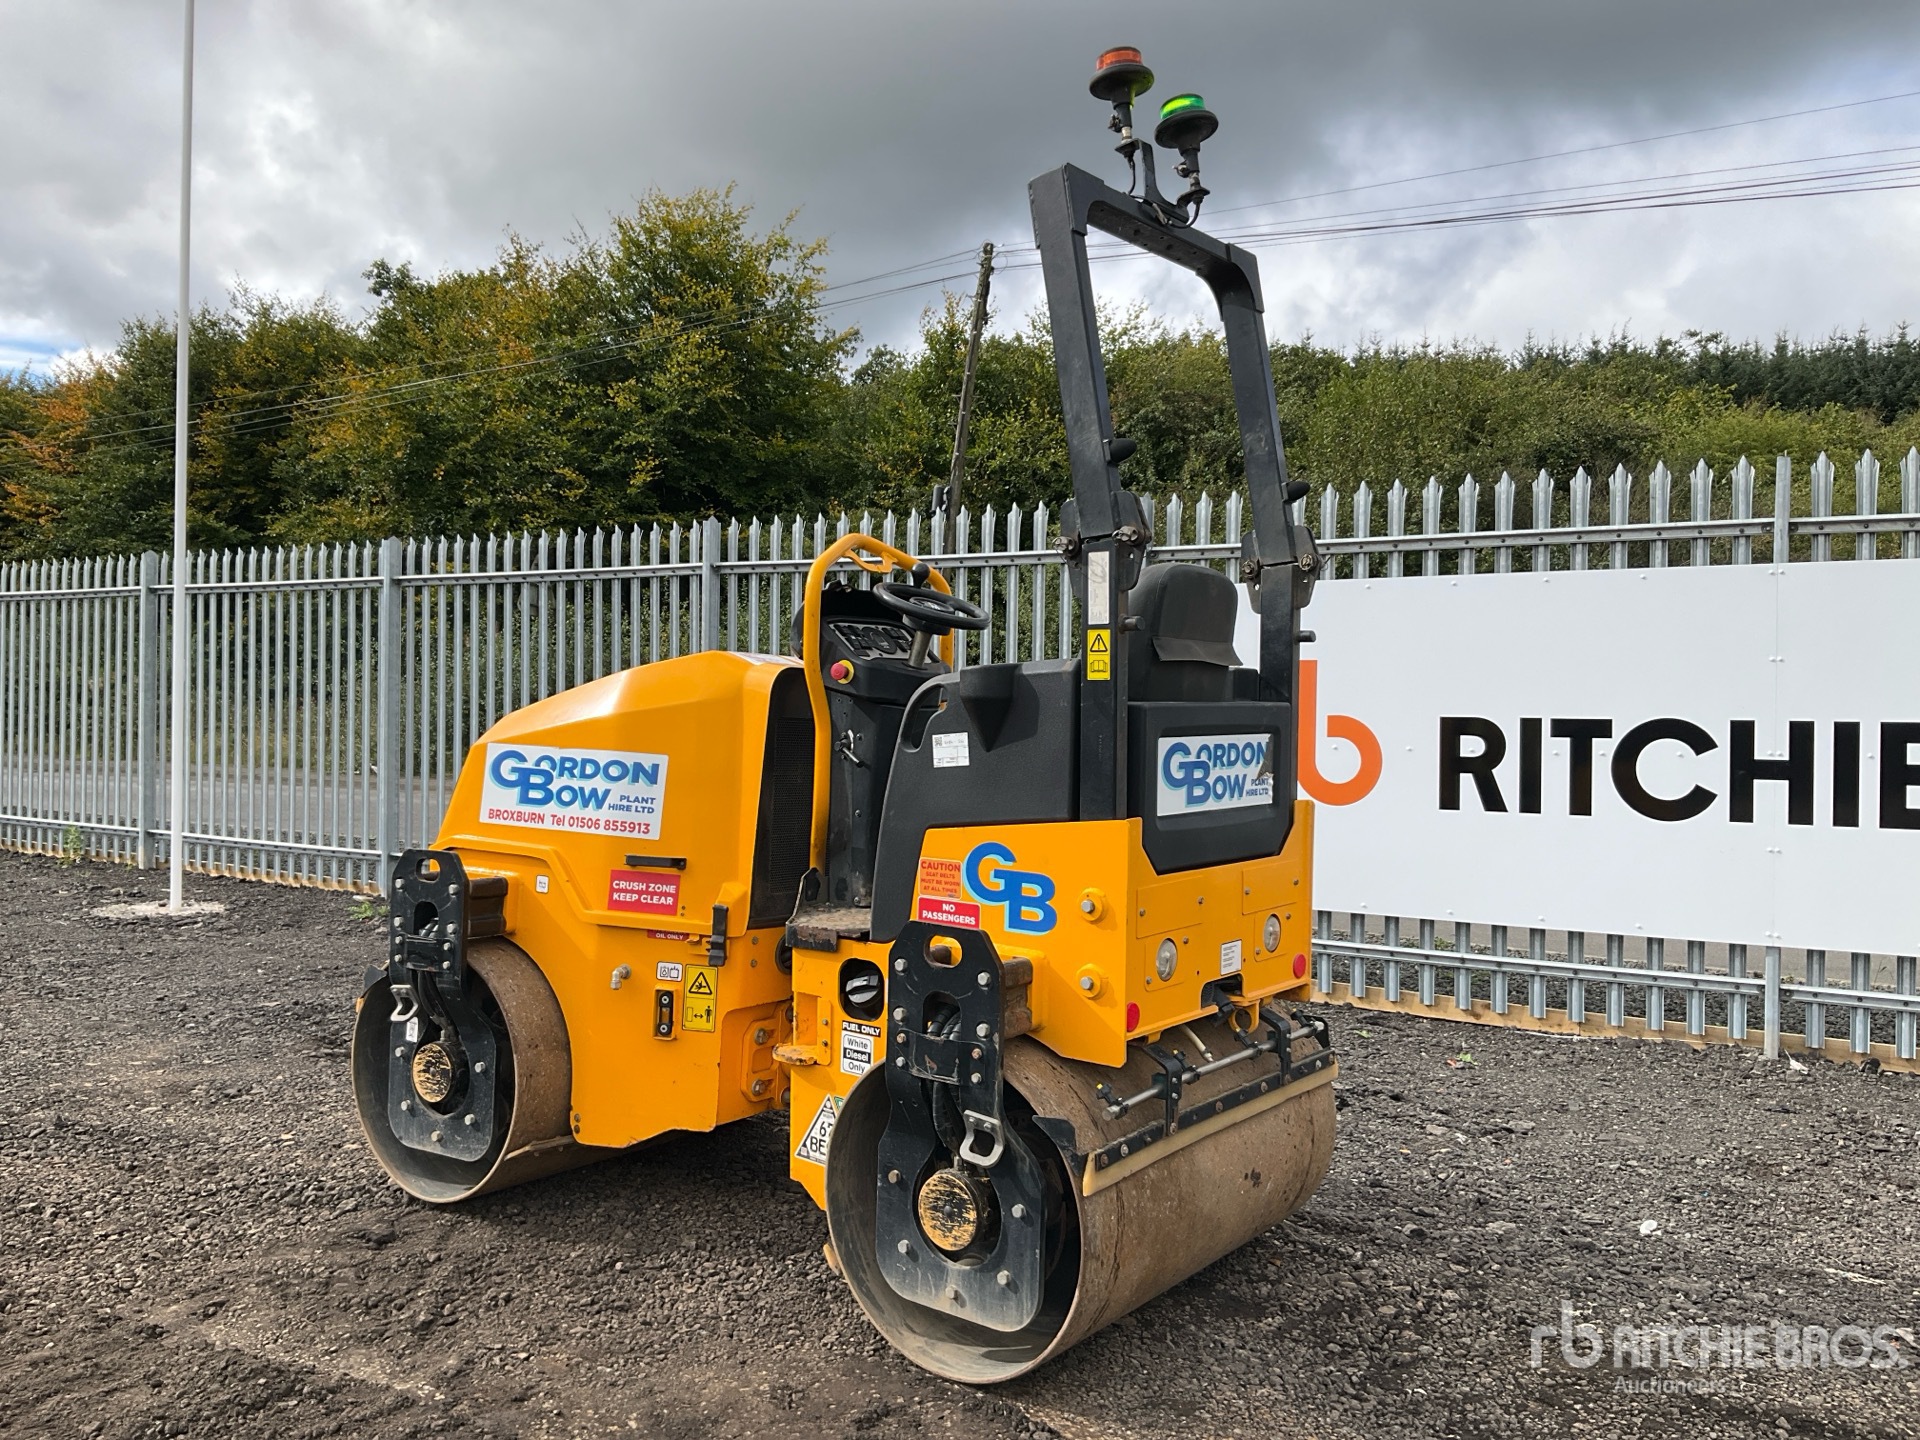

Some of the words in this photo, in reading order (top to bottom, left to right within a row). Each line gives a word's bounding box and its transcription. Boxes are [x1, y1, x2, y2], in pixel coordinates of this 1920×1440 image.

[490, 750, 660, 789] GORDON
[1162, 742, 1268, 790] GORDON
[1438, 715, 1920, 830] RITCHIE
[515, 767, 611, 811] BOW
[1181, 760, 1247, 808] BOW
[1250, 778, 1269, 787] PLANT
[1246, 787, 1258, 797] HIRE
[1258, 787, 1269, 796] LTD
[619, 794, 656, 805] PLANT
[608, 803, 632, 812] HIRE
[634, 805, 655, 814] LTD
[488, 808, 546, 825] BROXBURN
[550, 814, 566, 827] Tel
[568, 816, 601, 830] 01506
[603, 819, 651, 835] 855913
[920, 861, 961, 872] CAUTION
[612, 880, 646, 893] CRUSH
[648, 882, 677, 894] ZONE
[963, 841, 1057, 936] GB
[612, 892, 638, 903] KEEP
[640, 894, 674, 905] CLEAR
[942, 903, 955, 912] NO
[922, 910, 976, 925] PASSENGERS
[842, 1021, 860, 1032] FUEL
[861, 1025, 880, 1036] ONLY
[847, 1038, 868, 1049] White
[846, 1049, 869, 1061] Diesel
[848, 1061, 865, 1074] Only
[810, 1136, 829, 1156] BE
